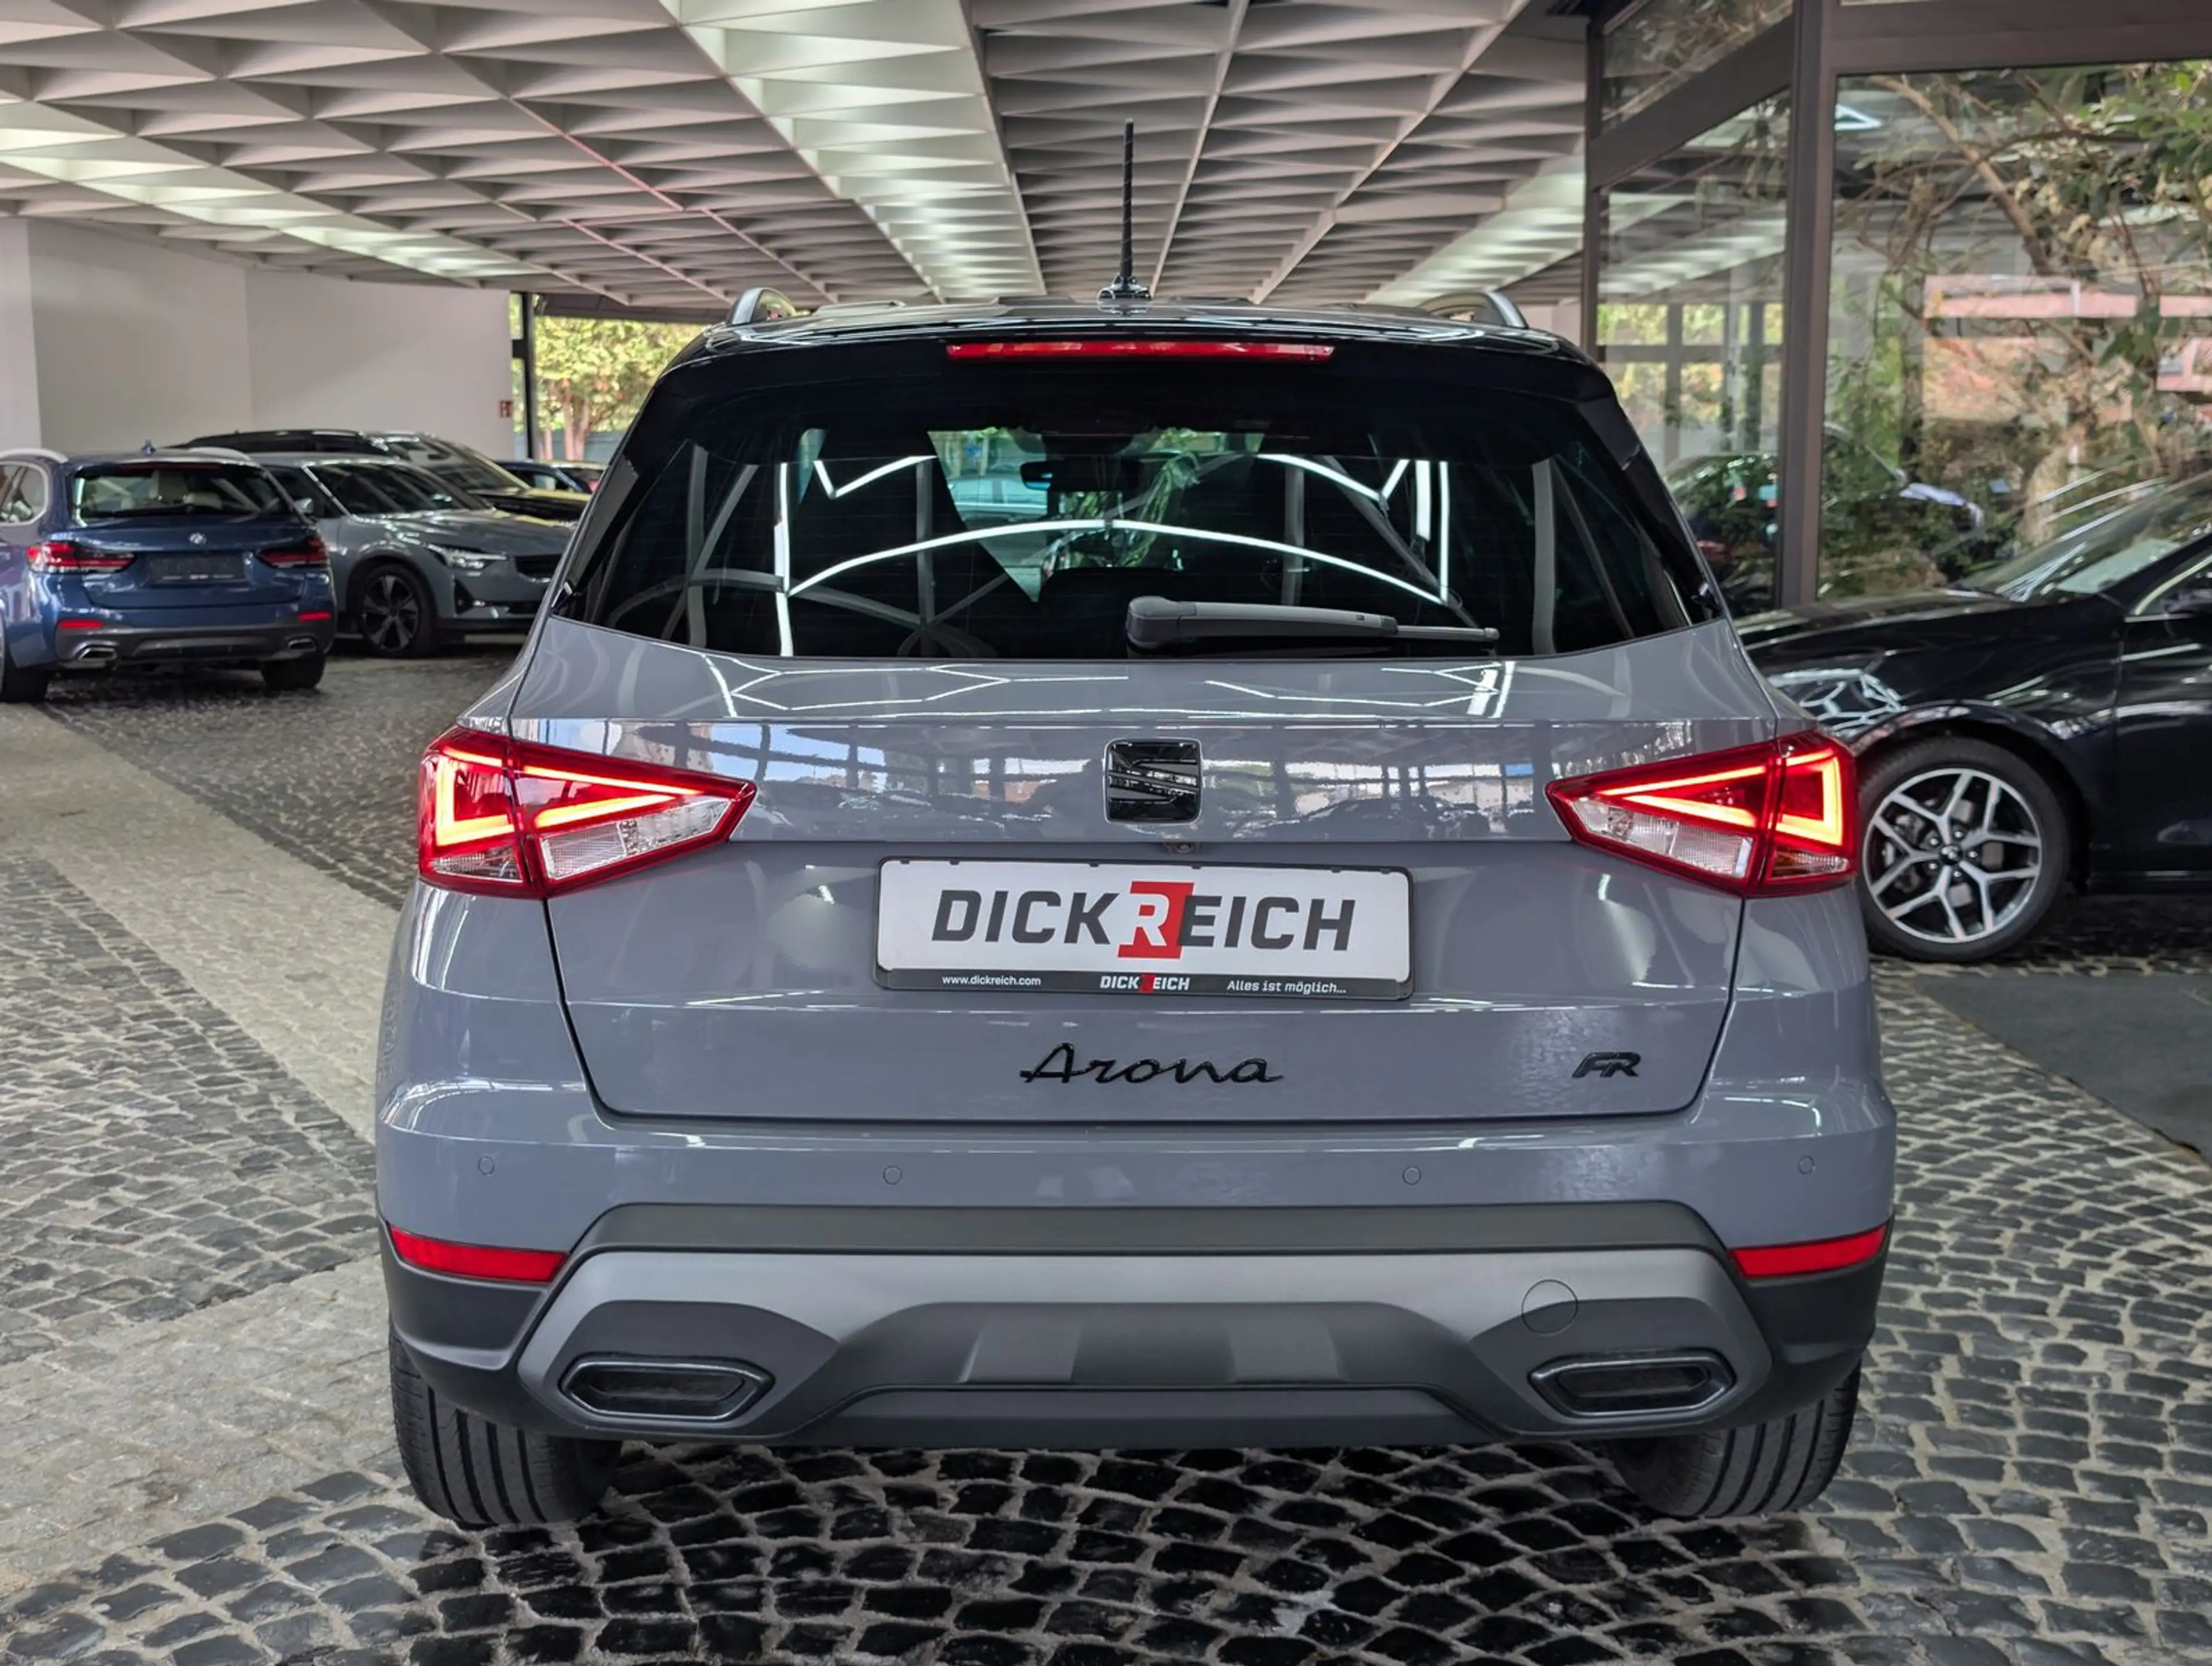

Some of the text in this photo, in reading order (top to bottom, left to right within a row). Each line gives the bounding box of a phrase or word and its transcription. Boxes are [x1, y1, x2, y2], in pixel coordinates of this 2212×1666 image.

[932, 880, 1356, 960] DICKREICH
[941, 975, 1041, 986] www.dickreich.com
[1099, 974, 1191, 991] DICKEICH
[1227, 980, 1260, 992] Alles
[1262, 980, 1282, 992] ist
[1019, 1042, 1284, 1083] Arona
[1571, 1052, 1641, 1078] FR
